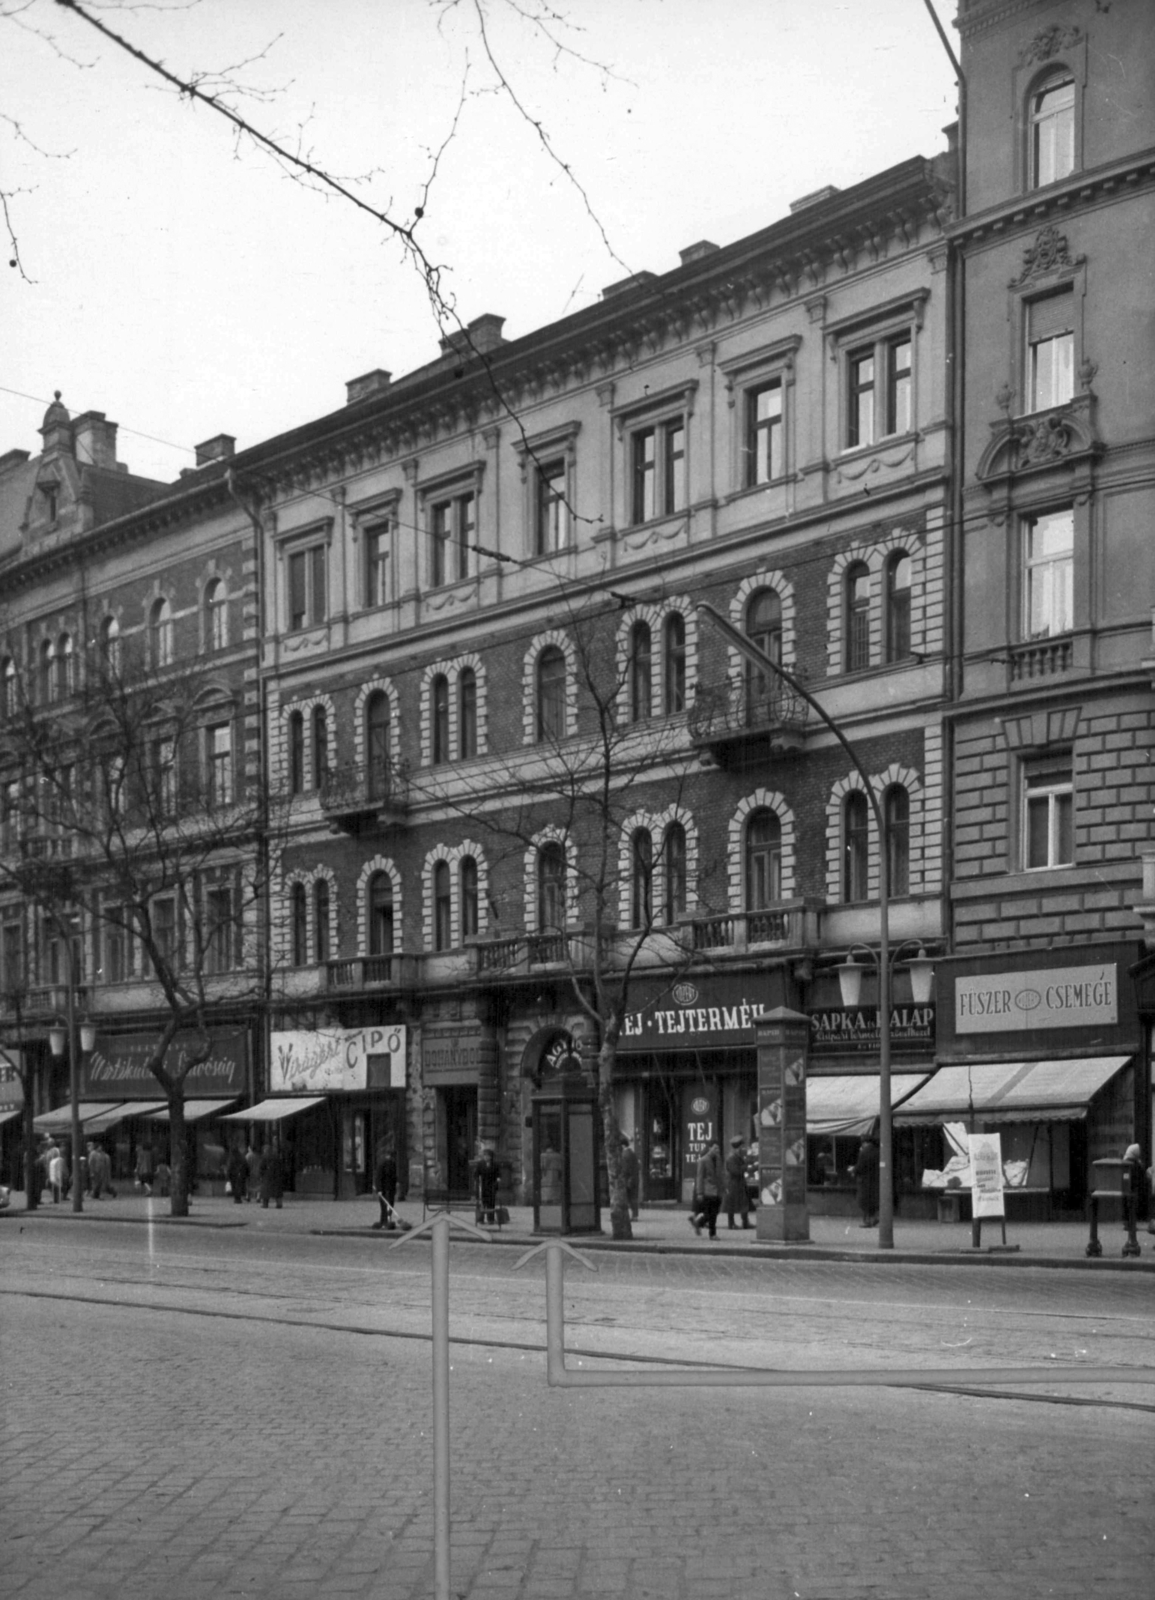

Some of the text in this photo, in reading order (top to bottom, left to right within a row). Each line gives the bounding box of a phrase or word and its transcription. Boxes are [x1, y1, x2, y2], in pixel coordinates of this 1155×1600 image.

[619, 1013, 642, 1036] EJ
[811, 1011, 867, 1031] SAPKA
[346, 1027, 402, 1069] CIPŐ
[687, 1121, 713, 1141] TEJ
